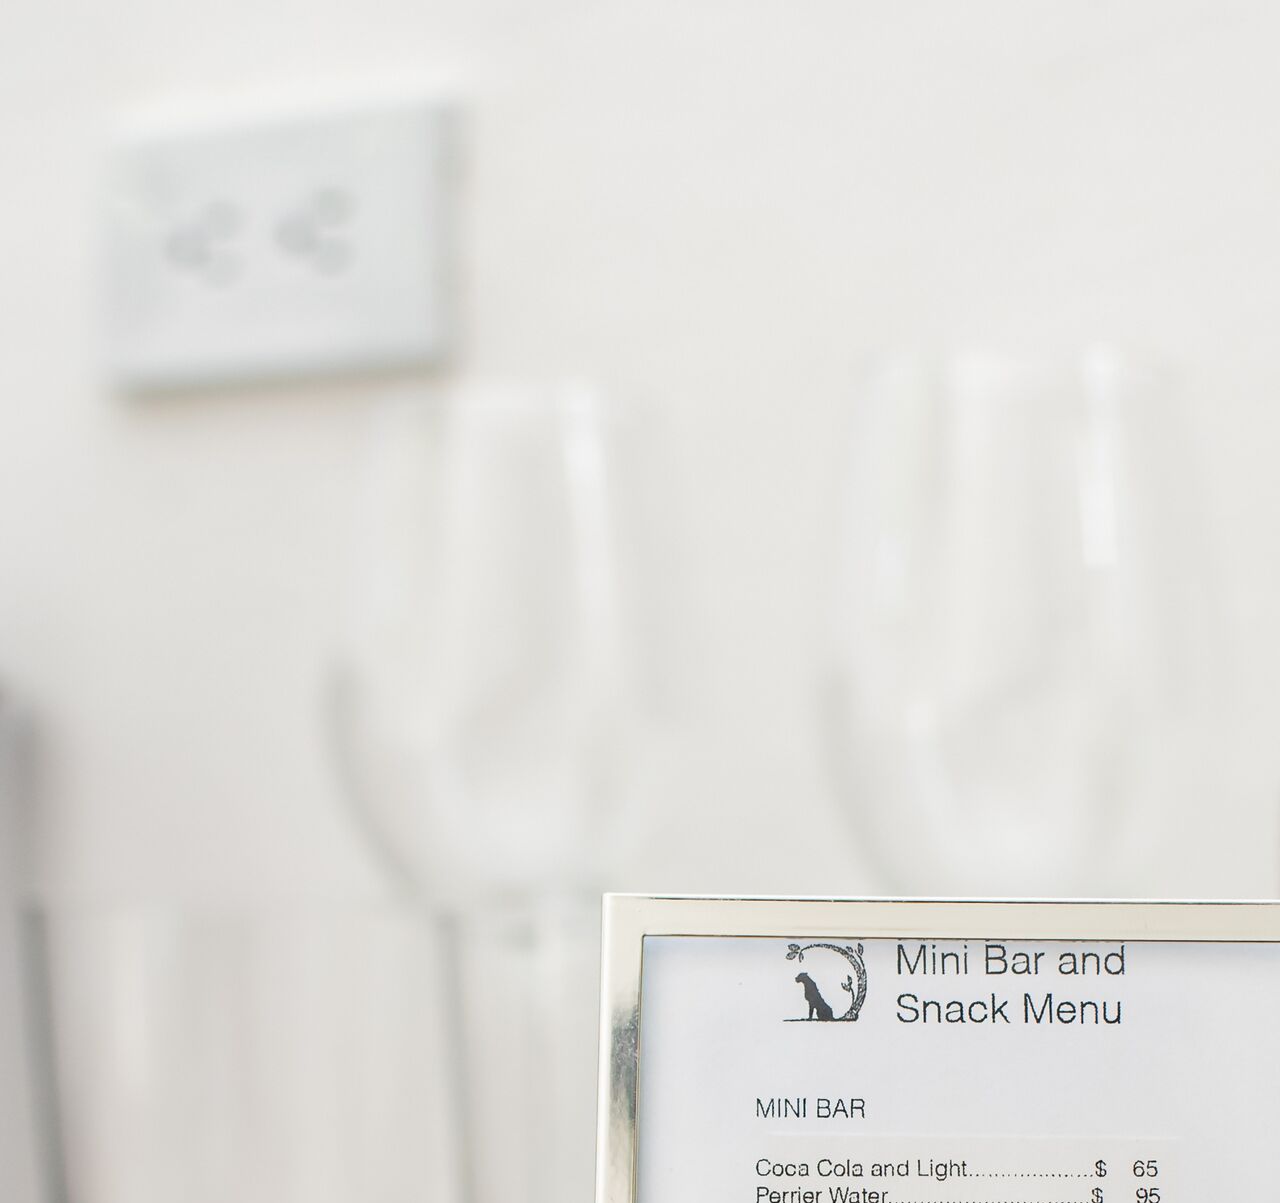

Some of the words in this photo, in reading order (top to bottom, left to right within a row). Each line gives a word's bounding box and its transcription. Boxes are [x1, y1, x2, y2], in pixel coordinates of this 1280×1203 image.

[896, 943, 968, 976] Mini
[984, 943, 1046, 976] Bar
[1057, 944, 1126, 976] and
[896, 992, 1011, 1024] Snack
[1023, 992, 1122, 1025] Menu
[756, 1097, 807, 1119] MINI
[816, 1097, 866, 1119] BAR
[755, 1158, 810, 1177] Coca
[816, 1158, 864, 1178] Cola
[870, 1159, 910, 1178] and
[917, 1158, 968, 1182] Light
[1094, 1159, 1108, 1178] $
[1132, 1159, 1159, 1178] 65
